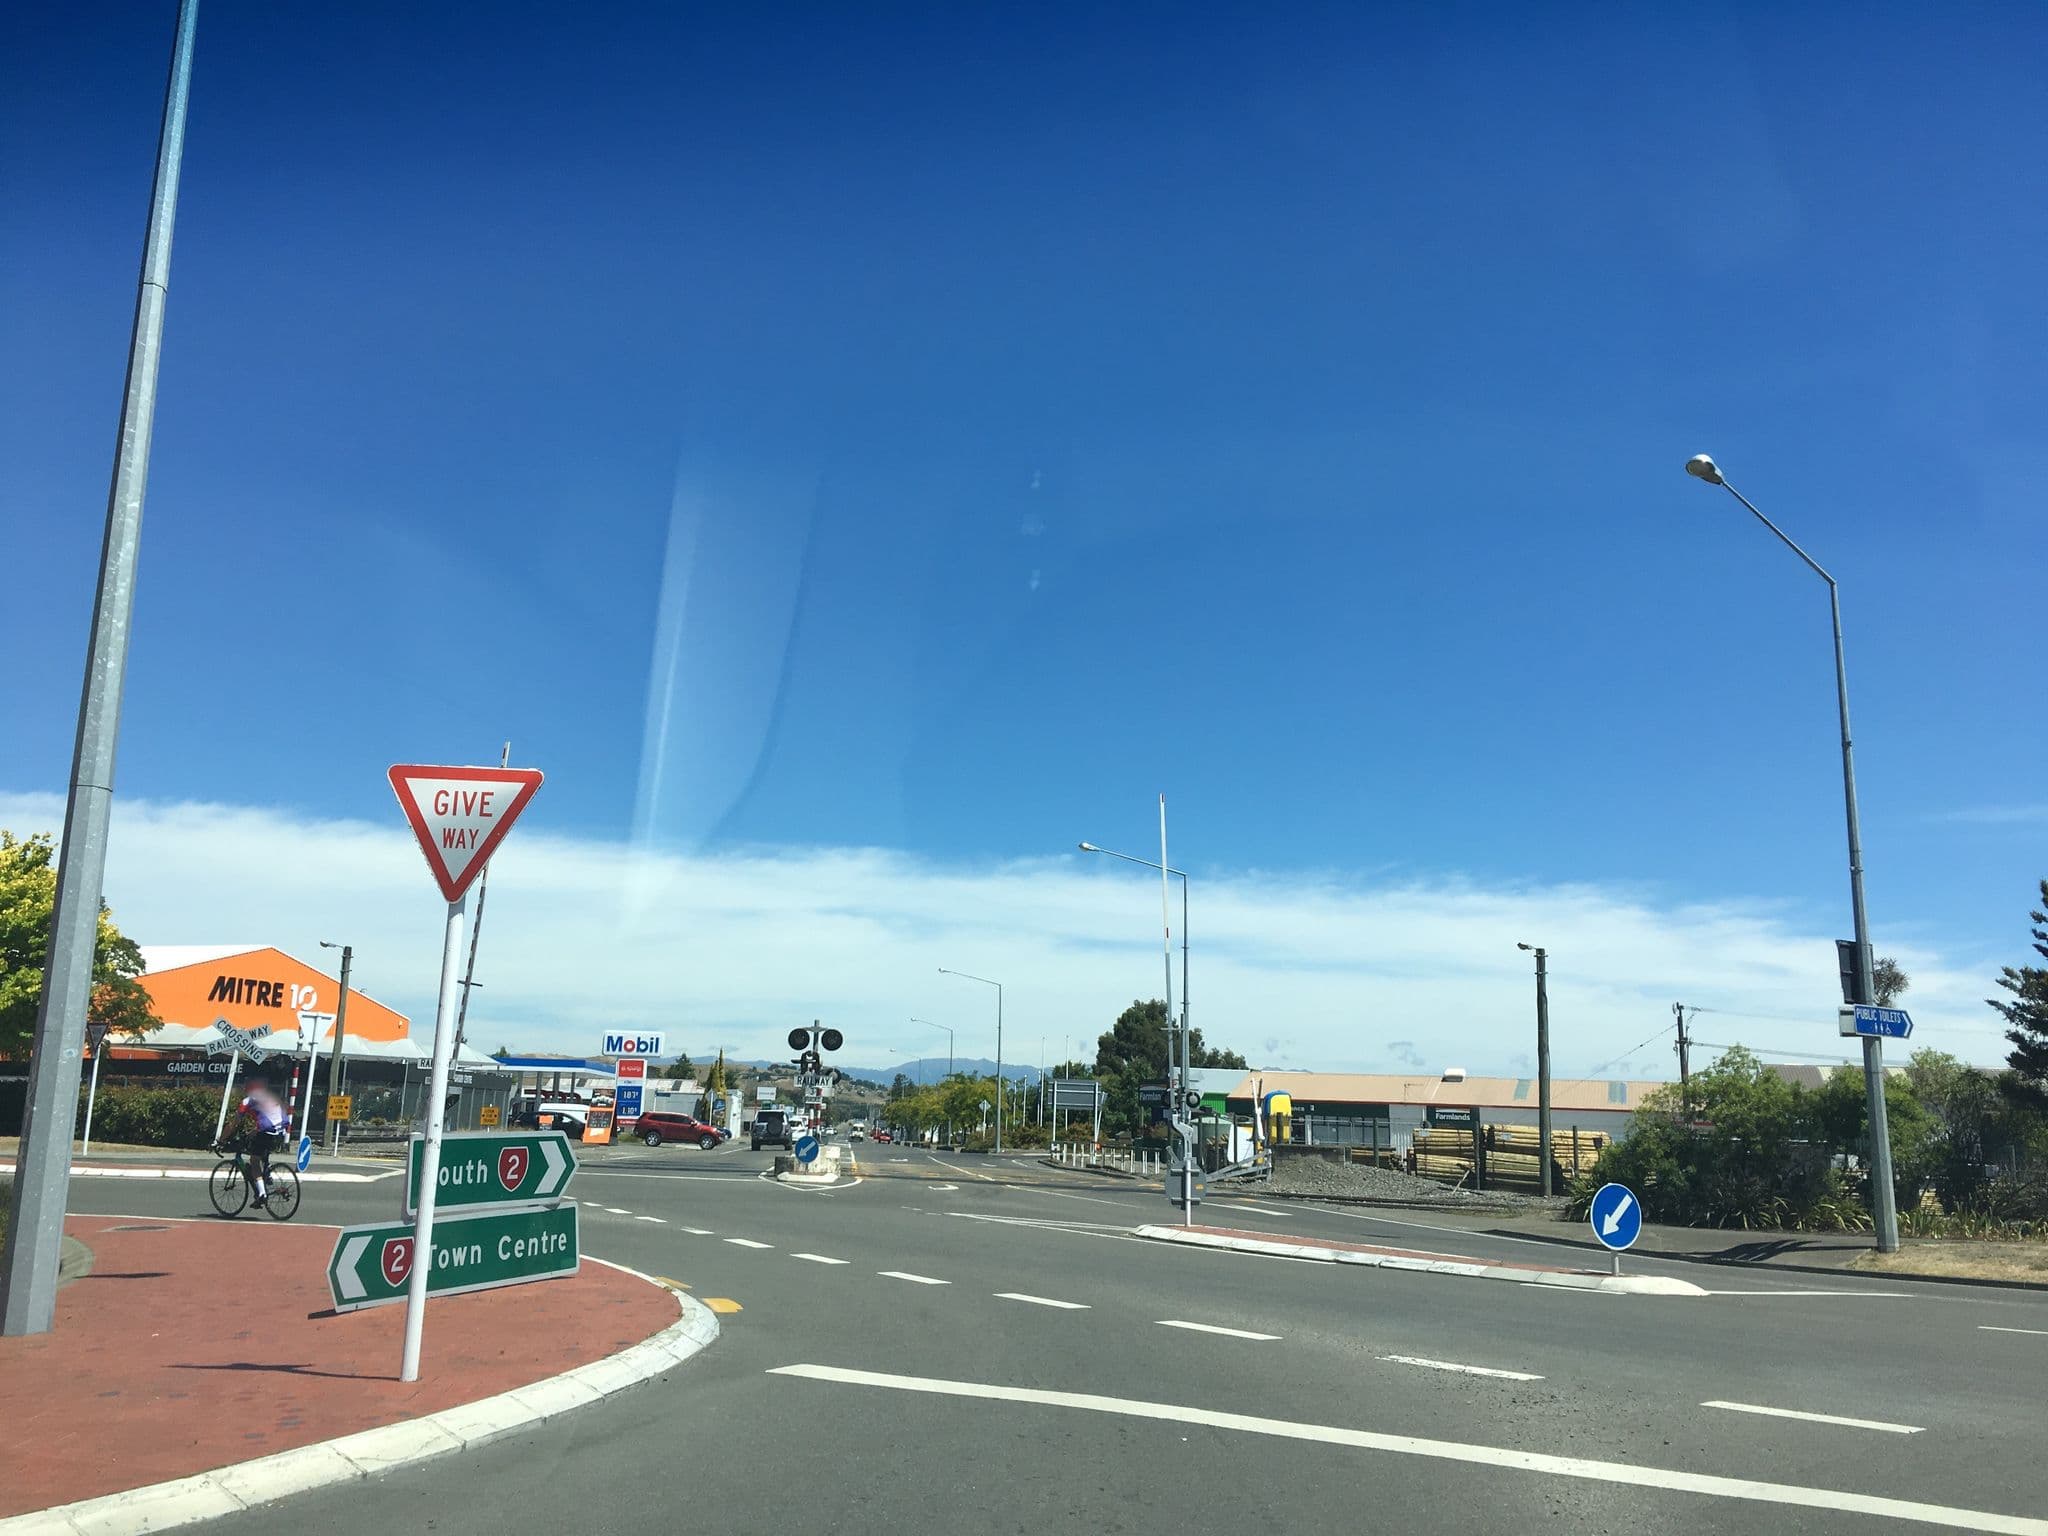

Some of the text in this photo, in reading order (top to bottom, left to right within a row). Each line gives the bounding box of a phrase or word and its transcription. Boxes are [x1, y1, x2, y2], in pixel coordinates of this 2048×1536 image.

[434, 789, 494, 817] GIVE
[442, 828, 479, 849] WAY
[208, 976, 318, 1010] MITRE 10
[1857, 1008, 1901, 1023] PUBLIC TOILETS
[209, 1025, 268, 1053] RAIL WAY
[217, 1019, 262, 1060] CROSSING
[606, 1035, 660, 1053] Mobil
[167, 1062, 243, 1074] GARDEN CENTE
[1435, 1112, 1471, 1121] Farmlands
[438, 1154, 520, 1186] outh 2
[390, 1230, 567, 1273] 2 Town Centre
